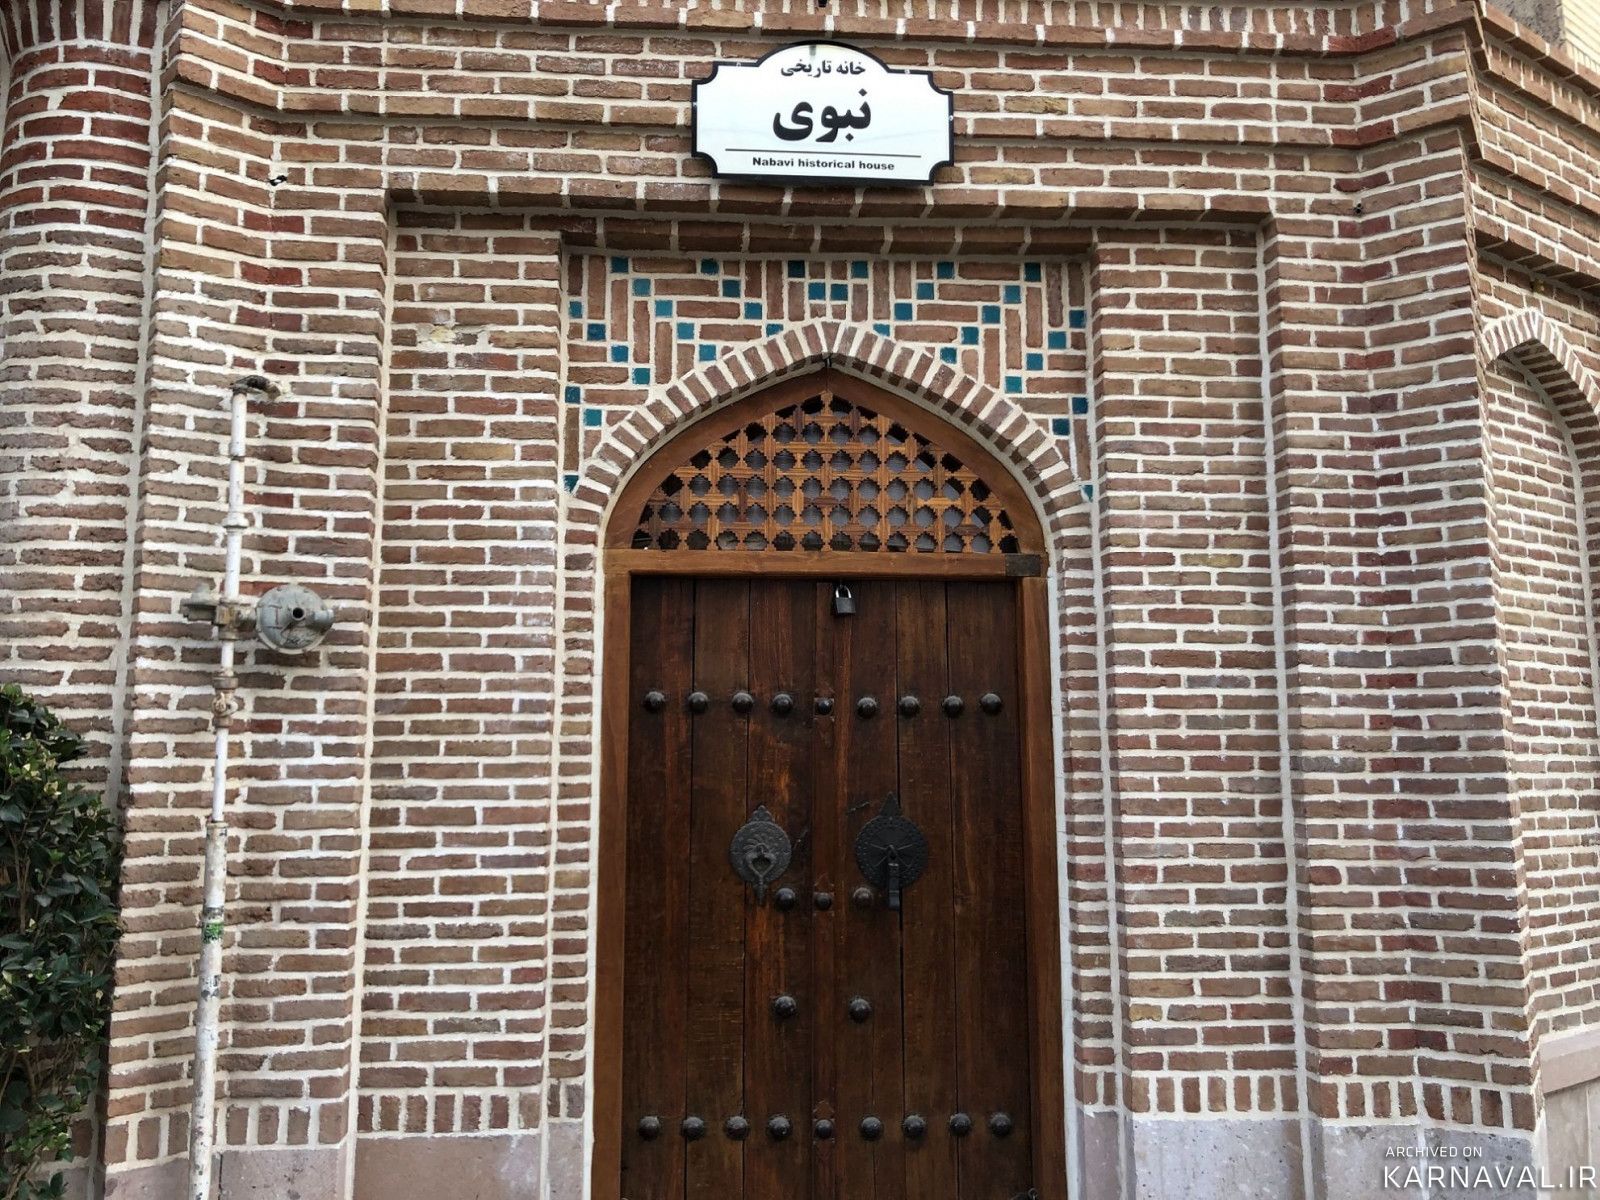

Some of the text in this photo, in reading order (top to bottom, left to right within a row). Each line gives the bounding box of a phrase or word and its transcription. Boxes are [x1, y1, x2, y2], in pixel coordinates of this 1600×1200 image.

[781, 59, 866, 78] خانه تاریخی
[773, 88, 871, 143] نبوی
[752, 157, 895, 171] Nabavi historical house
